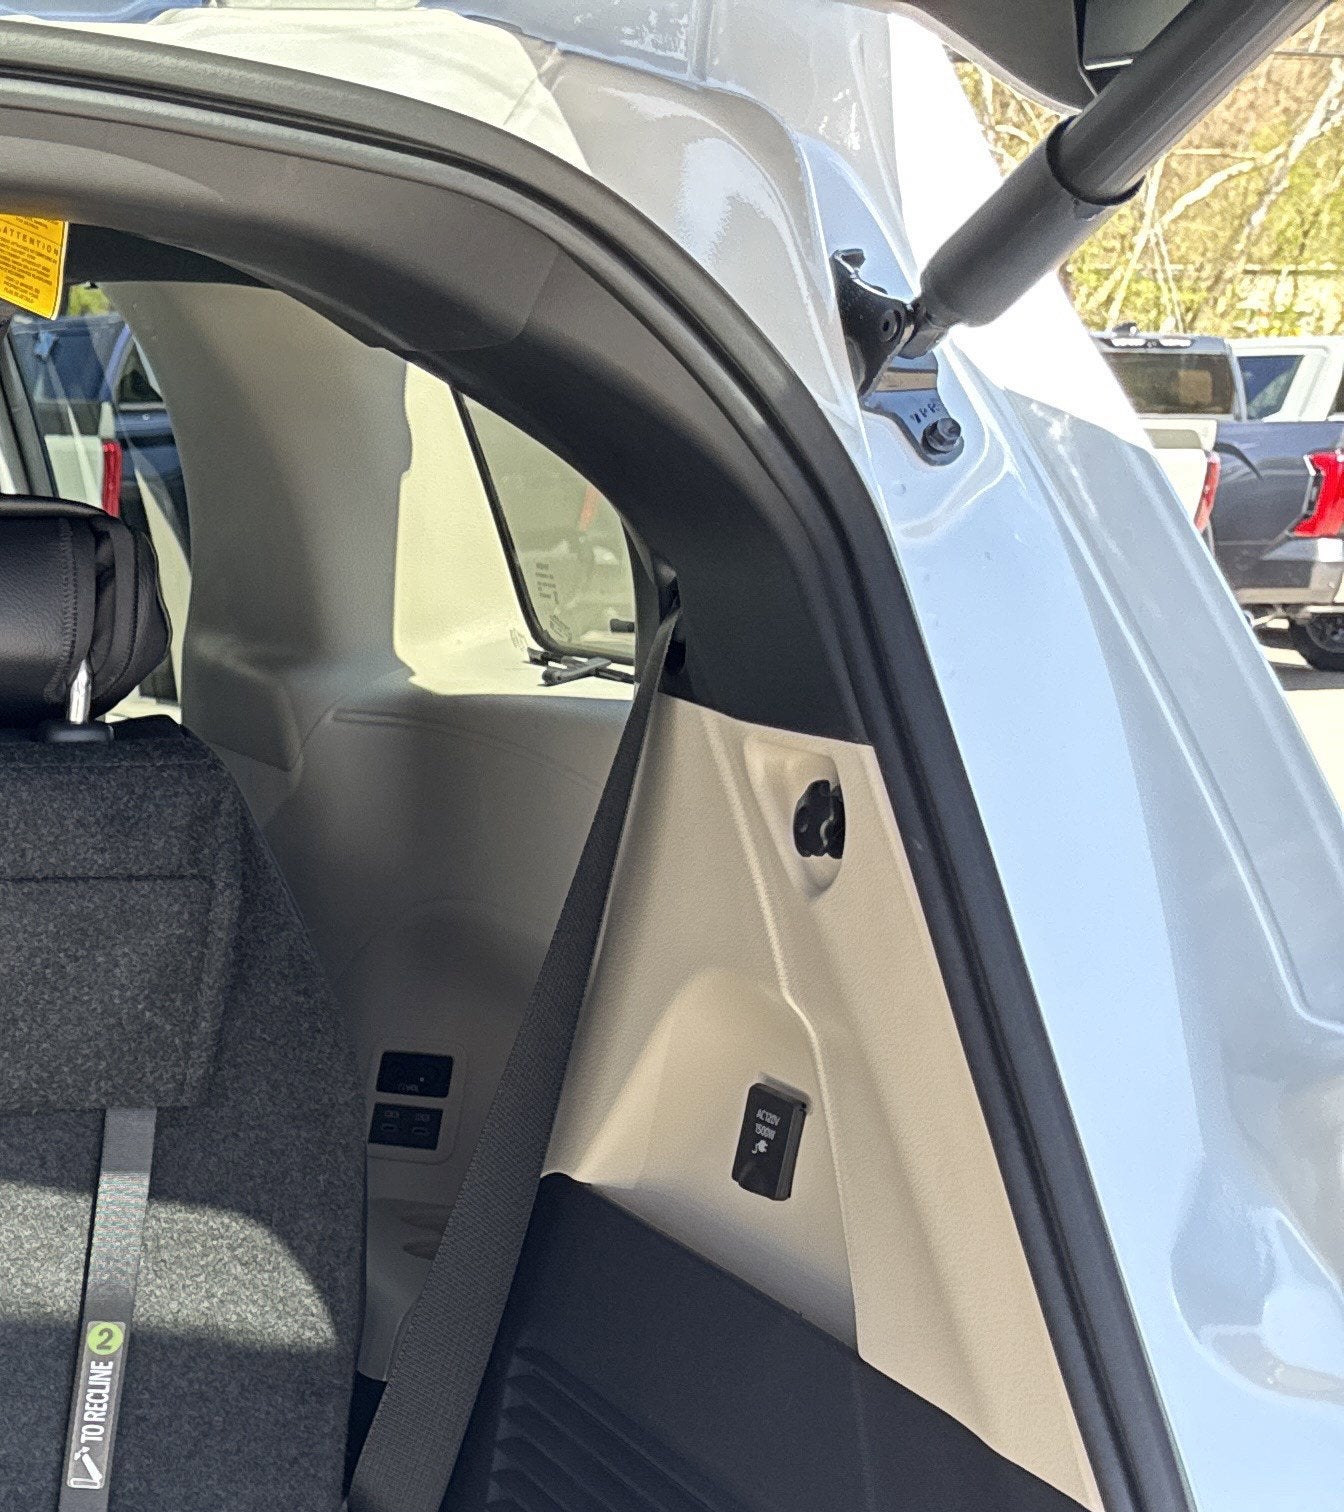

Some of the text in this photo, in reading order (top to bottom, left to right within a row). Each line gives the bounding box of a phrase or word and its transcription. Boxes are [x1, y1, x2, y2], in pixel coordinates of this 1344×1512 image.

[3, 226, 59, 255] ATTENTION
[96, 1328, 114, 1350] 2
[80, 1361, 114, 1443] TO RECLINE
